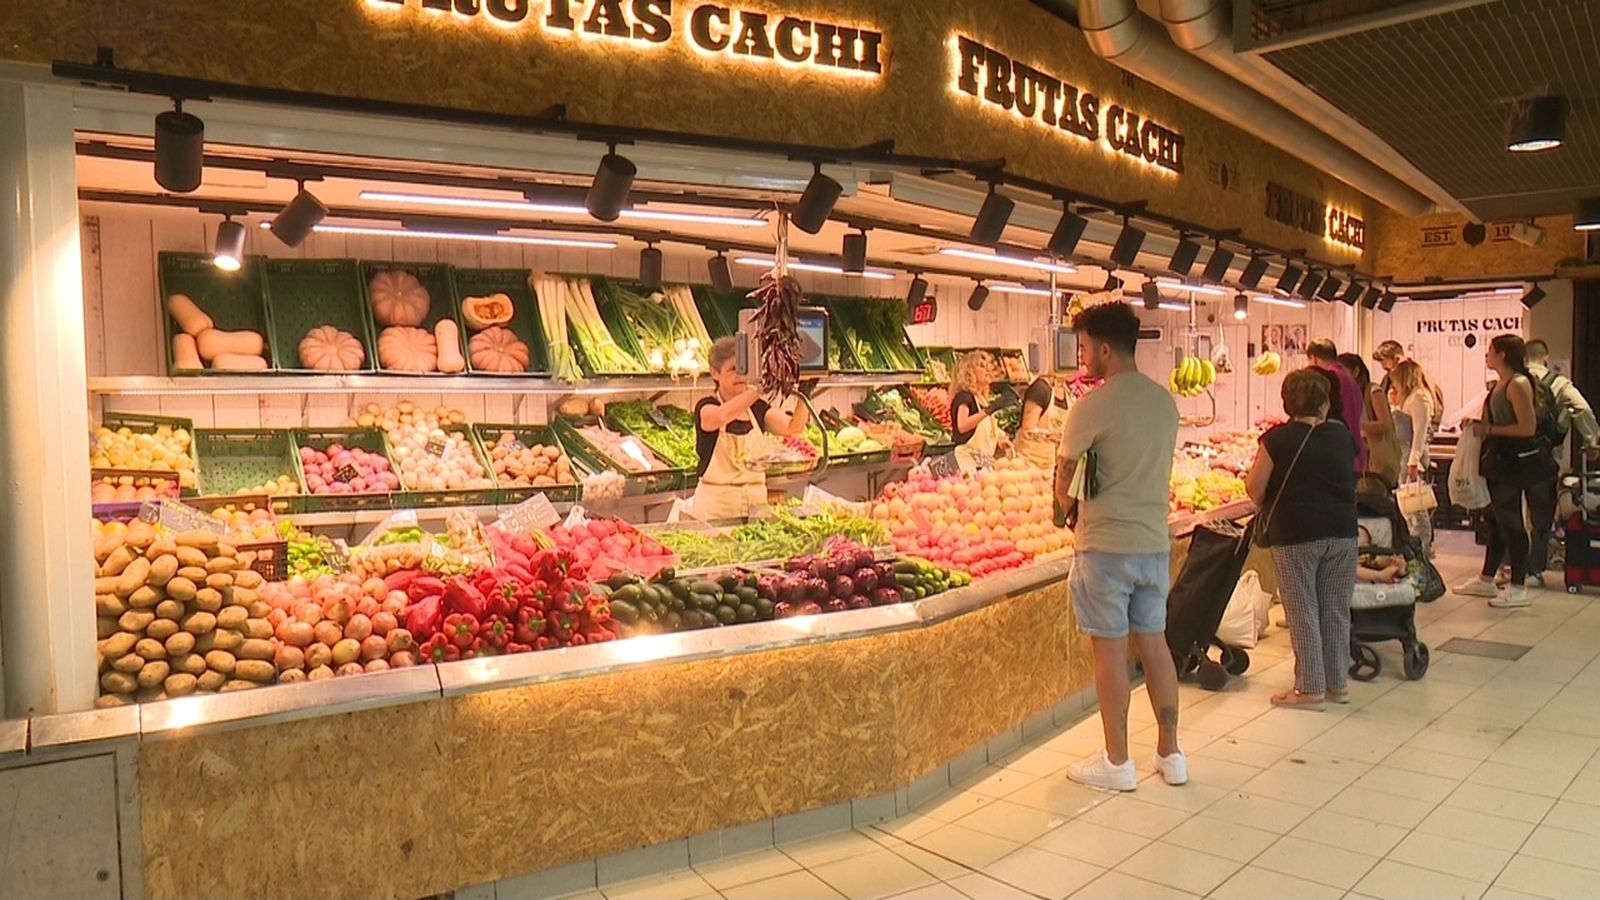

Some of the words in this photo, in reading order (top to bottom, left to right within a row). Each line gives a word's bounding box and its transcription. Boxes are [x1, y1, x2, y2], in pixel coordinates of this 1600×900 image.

[369, 0, 672, 43] TAS
[690, 4, 882, 73] CACHI
[958, 35, 1100, 142] FRUTAS
[1106, 104, 1185, 175] CACHI
[1329, 208, 1366, 251] CACHI
[1424, 231, 1454, 243] EST.
[1417, 319, 1478, 333] FRUTAS
